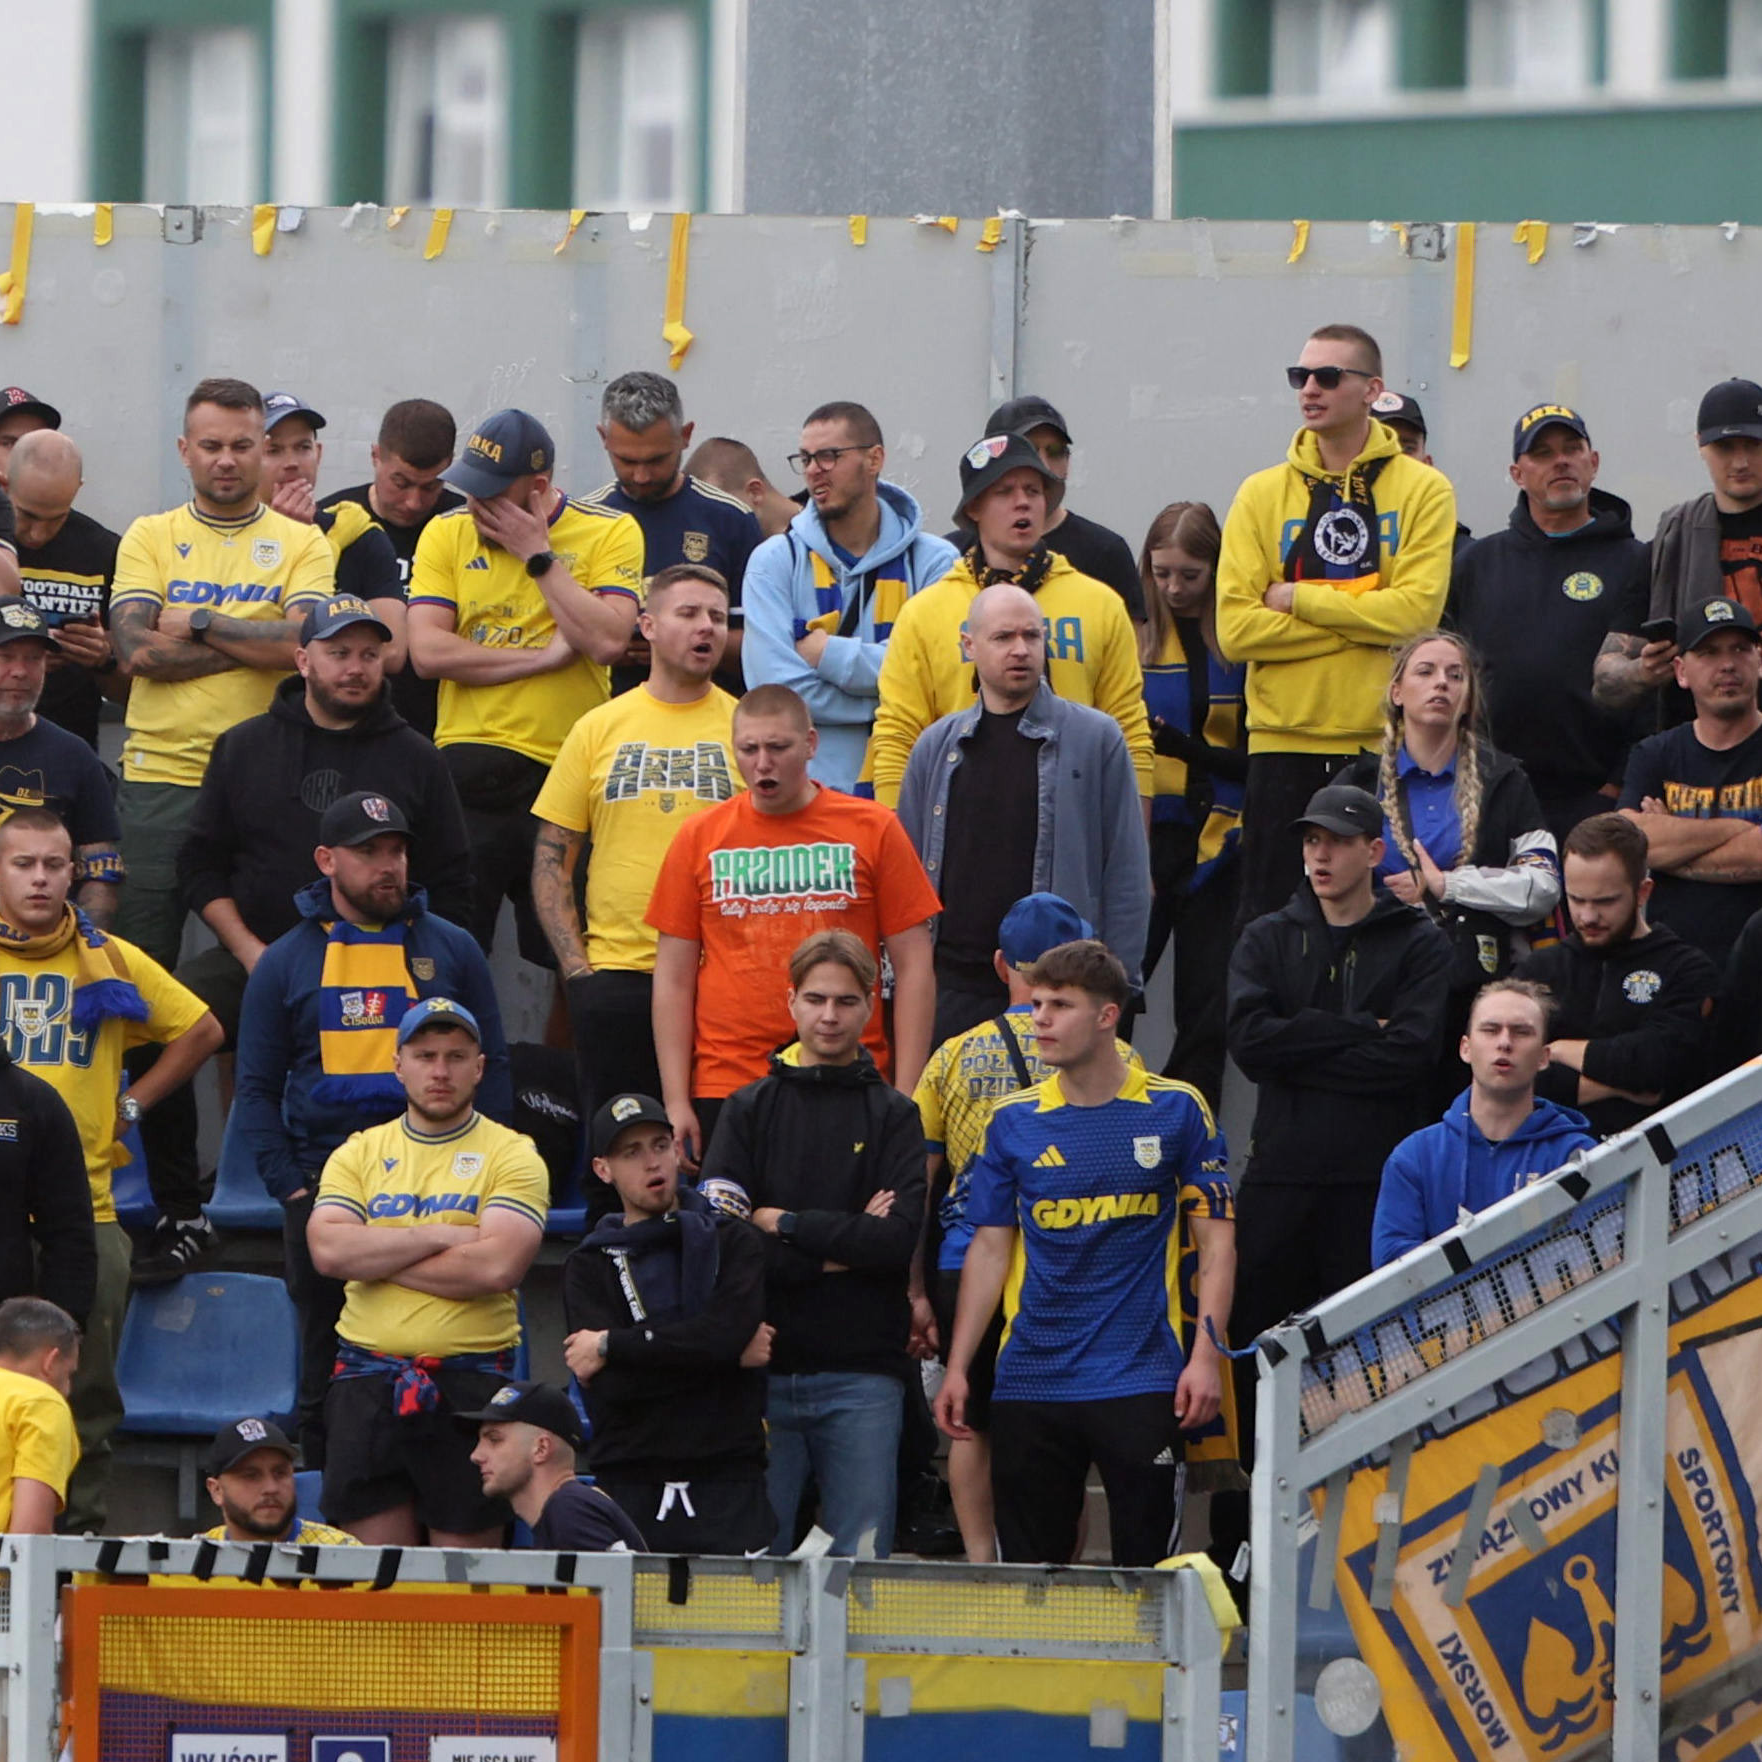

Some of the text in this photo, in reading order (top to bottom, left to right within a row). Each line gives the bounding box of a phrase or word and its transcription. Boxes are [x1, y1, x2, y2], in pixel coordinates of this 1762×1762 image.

[168, 579, 282, 606] GDYNIA
[605, 741, 736, 803] ARKA
[709, 843, 858, 902] PRZODEK
[368, 1193, 479, 1219] GDYNIA
[1031, 1193, 1159, 1229] GDYNIA
[1679, 1446, 1741, 1615] SPORTOWY
[1439, 1631, 1509, 1749] MORSKI
